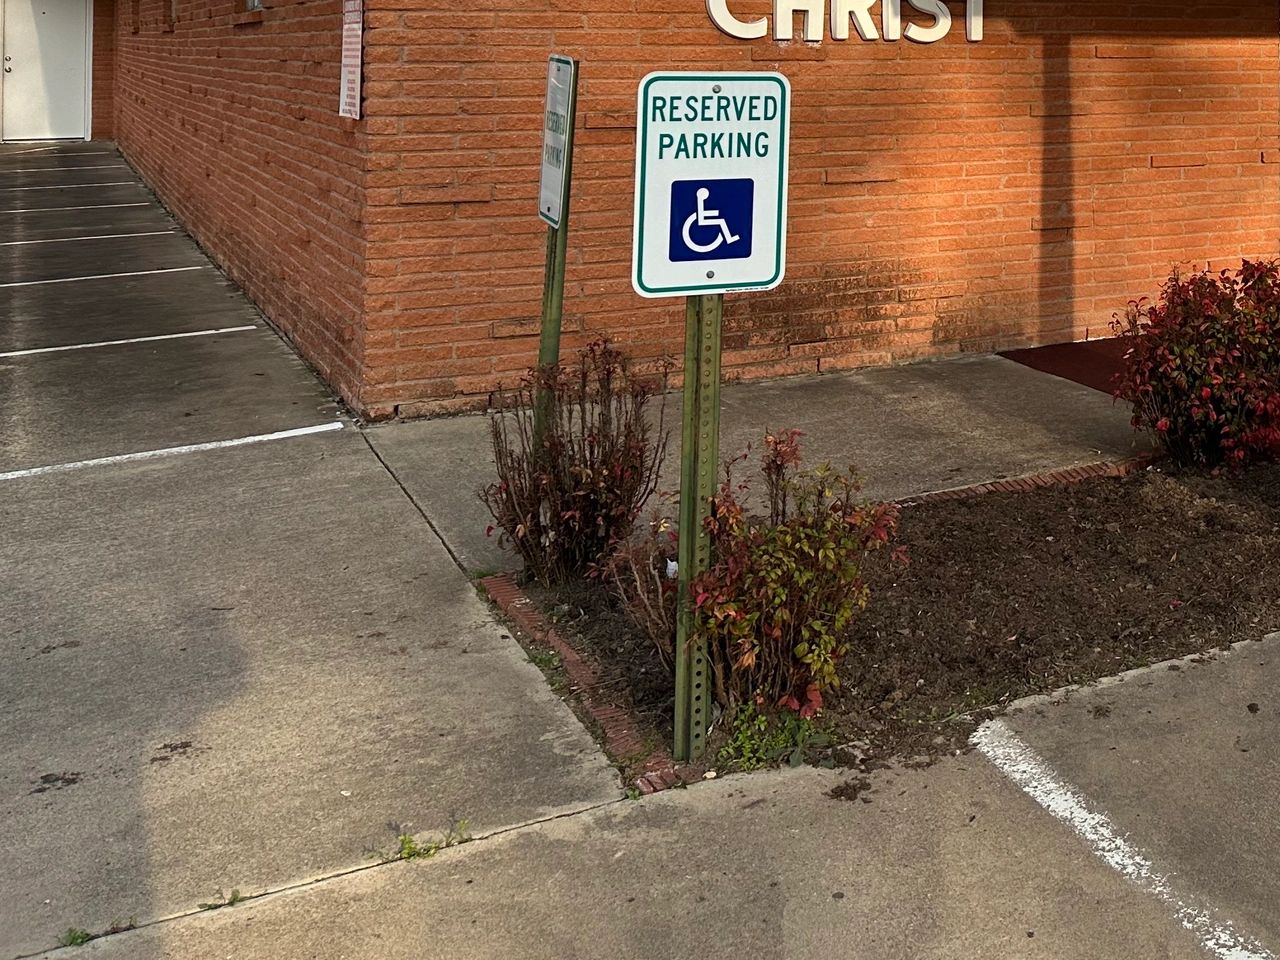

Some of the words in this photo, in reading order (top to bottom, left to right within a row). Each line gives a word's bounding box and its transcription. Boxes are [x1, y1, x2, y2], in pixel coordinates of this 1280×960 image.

[651, 95, 778, 122] RESERVED
[544, 143, 562, 170] PARKING
[658, 131, 769, 160] PARKING
